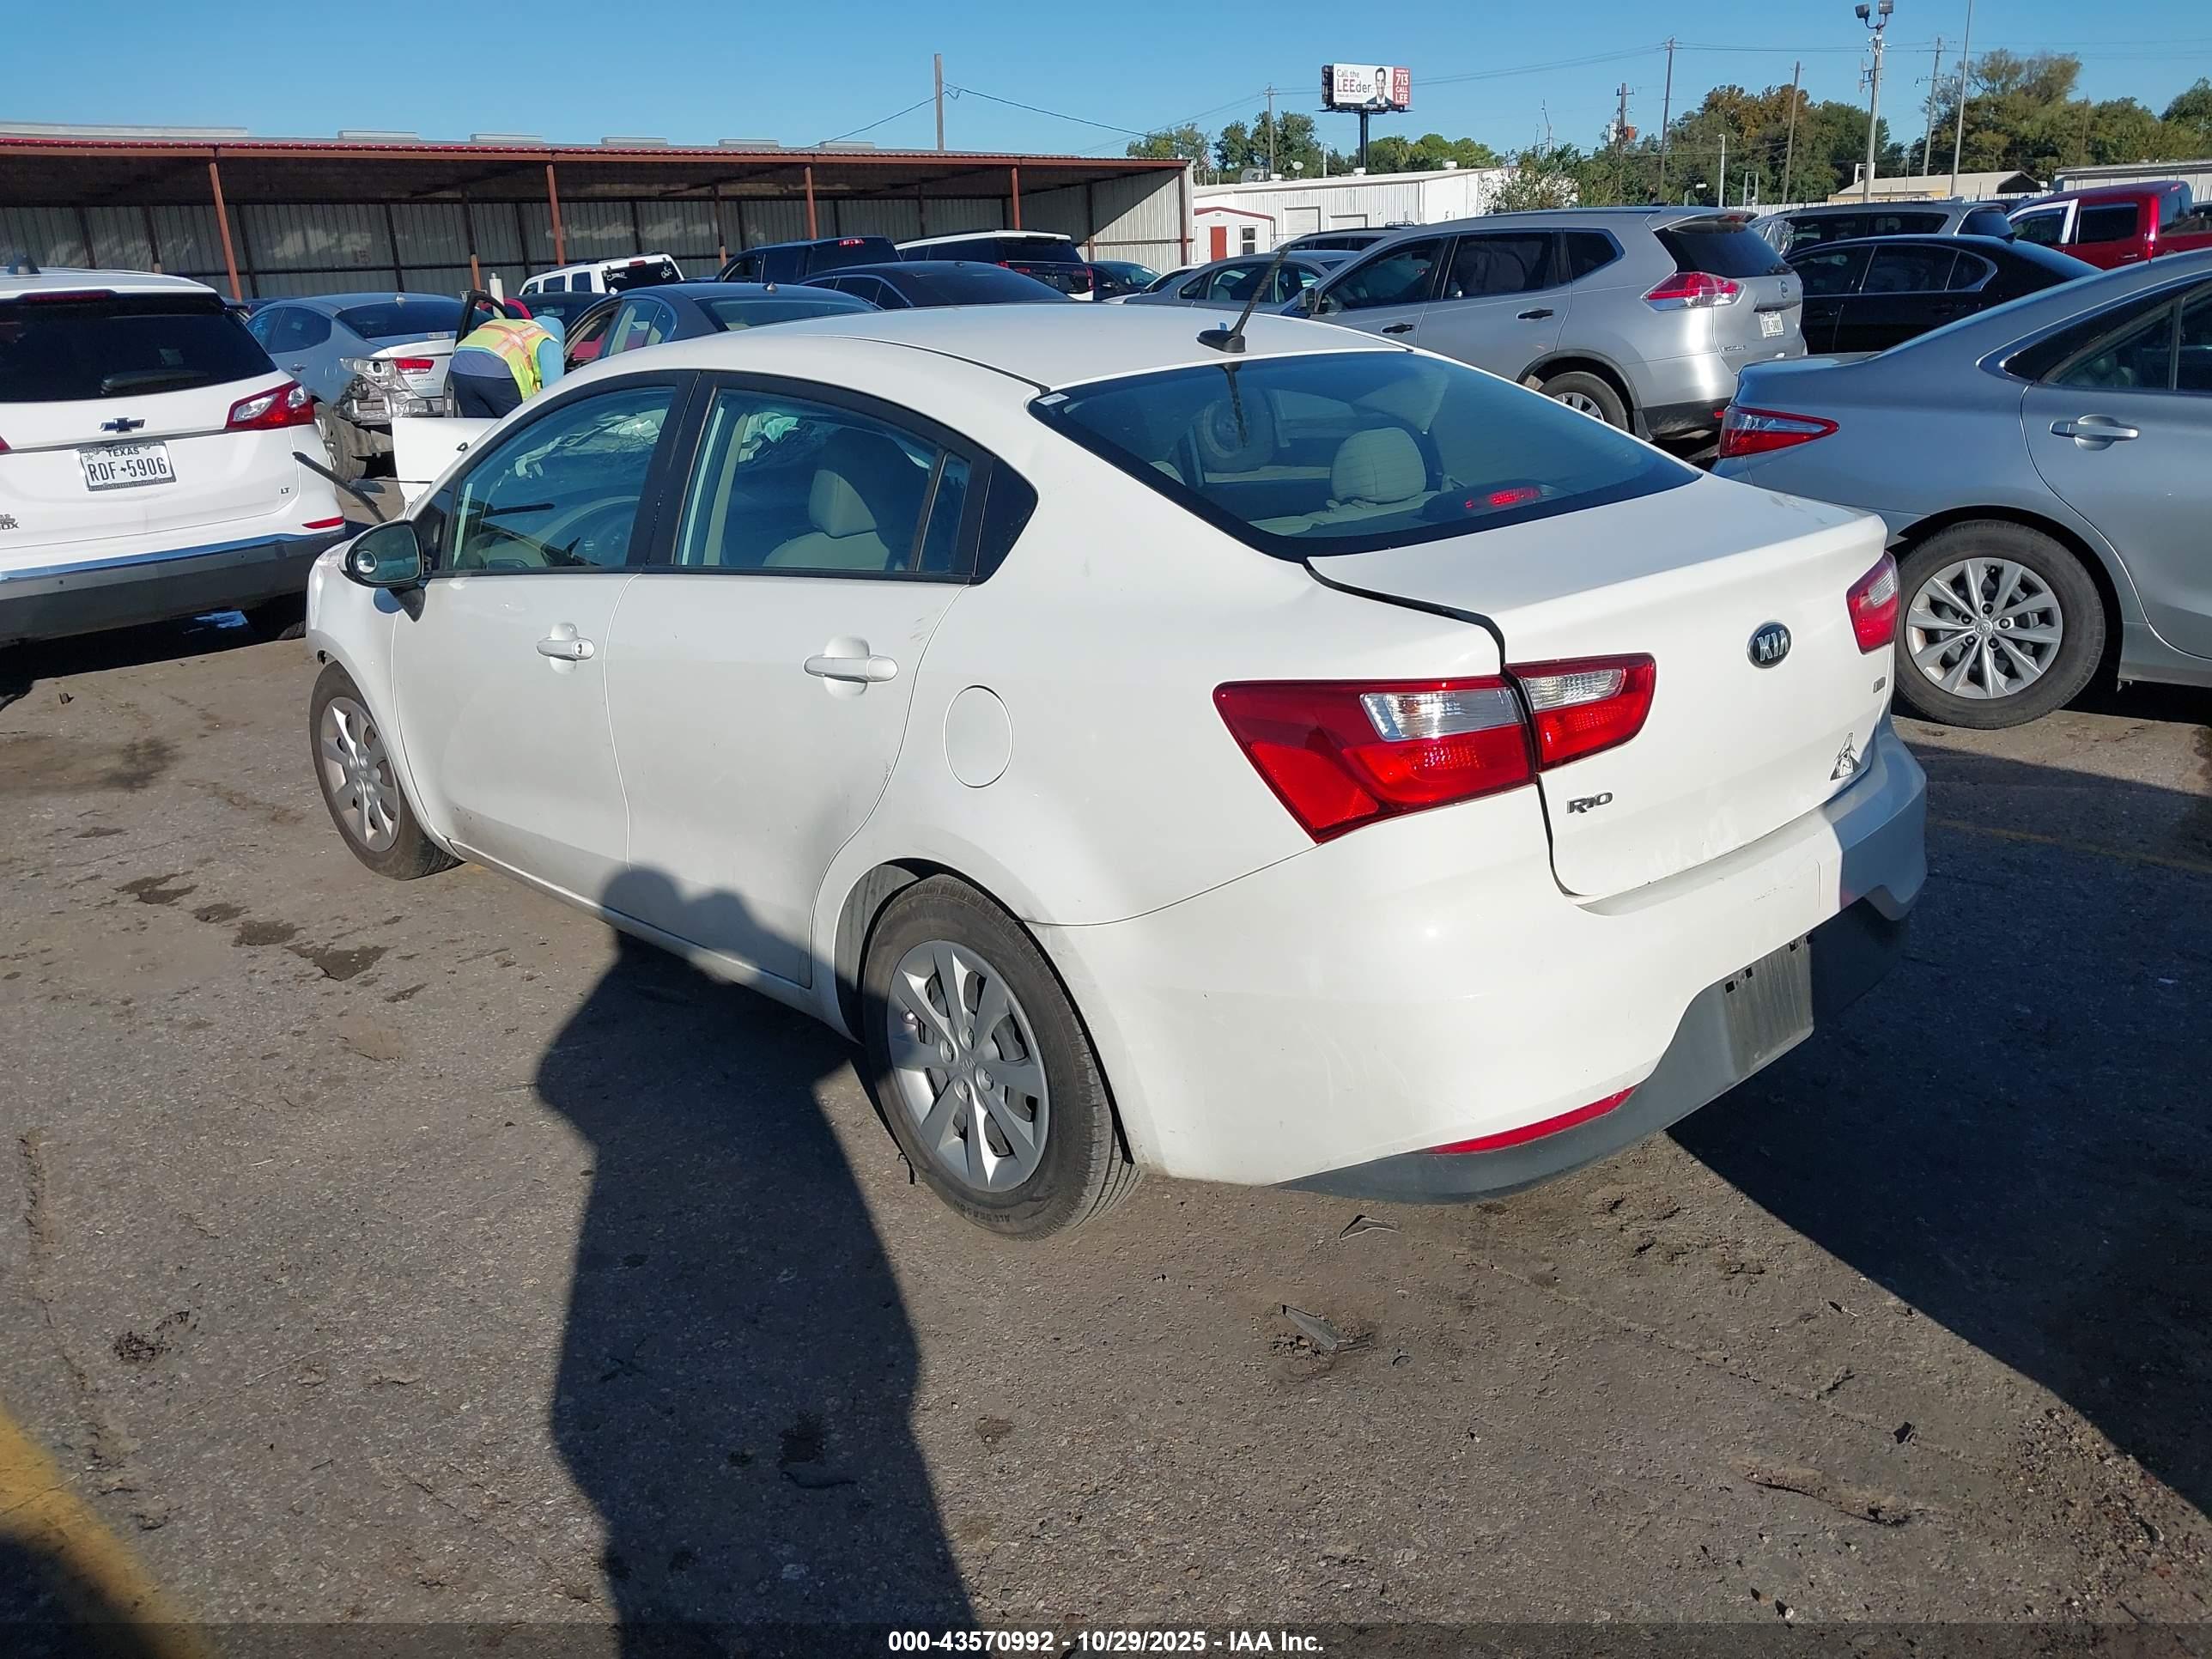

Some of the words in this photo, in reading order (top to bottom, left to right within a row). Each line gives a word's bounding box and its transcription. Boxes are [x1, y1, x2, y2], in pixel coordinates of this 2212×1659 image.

[1337, 69, 1349, 78] Call
[1395, 73, 1408, 86] 713
[1395, 94, 1408, 103] LEE
[106, 447, 140, 458] TEXAS
[87, 461, 116, 482] RDF
[126, 456, 167, 477] 5906
[1759, 629, 1789, 661] KIA
